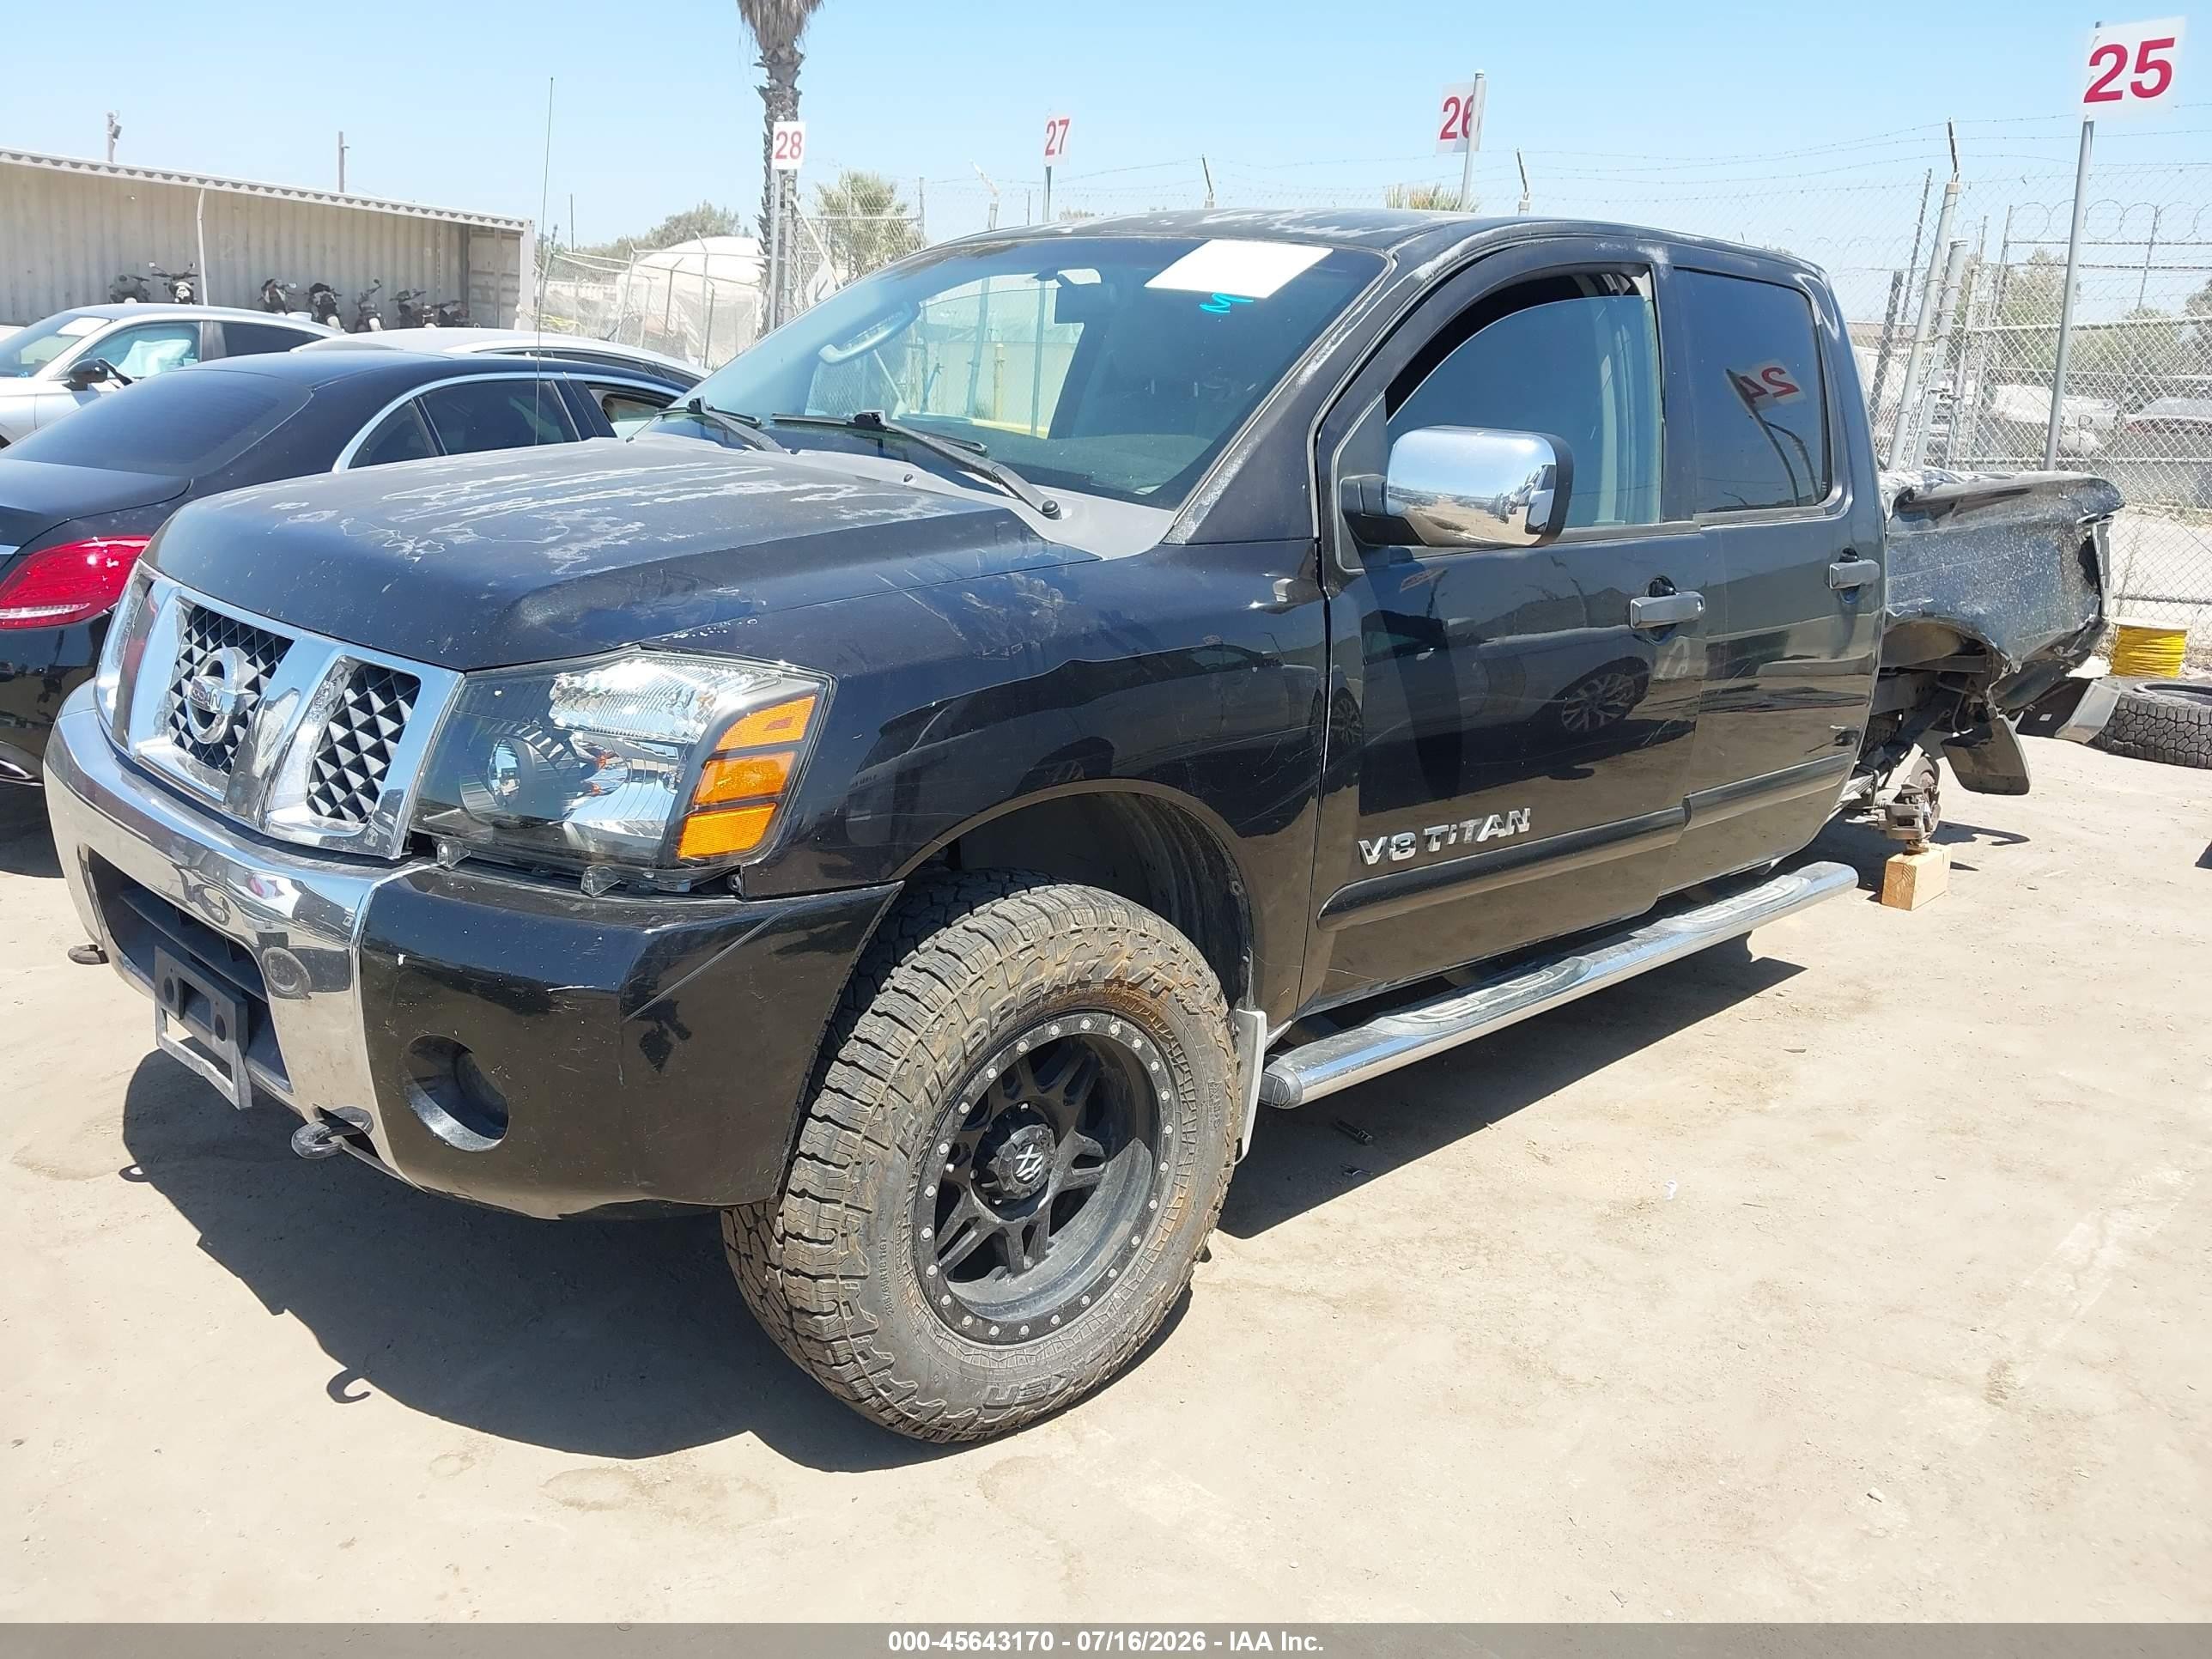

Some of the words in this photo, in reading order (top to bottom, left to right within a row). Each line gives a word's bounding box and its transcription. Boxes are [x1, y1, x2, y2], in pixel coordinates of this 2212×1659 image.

[2083, 37, 2175, 103] 25
[775, 131, 802, 160] 28
[1045, 118, 1070, 156] 27
[1358, 831, 1417, 866] V8
[1422, 807, 1532, 853] TITAN
